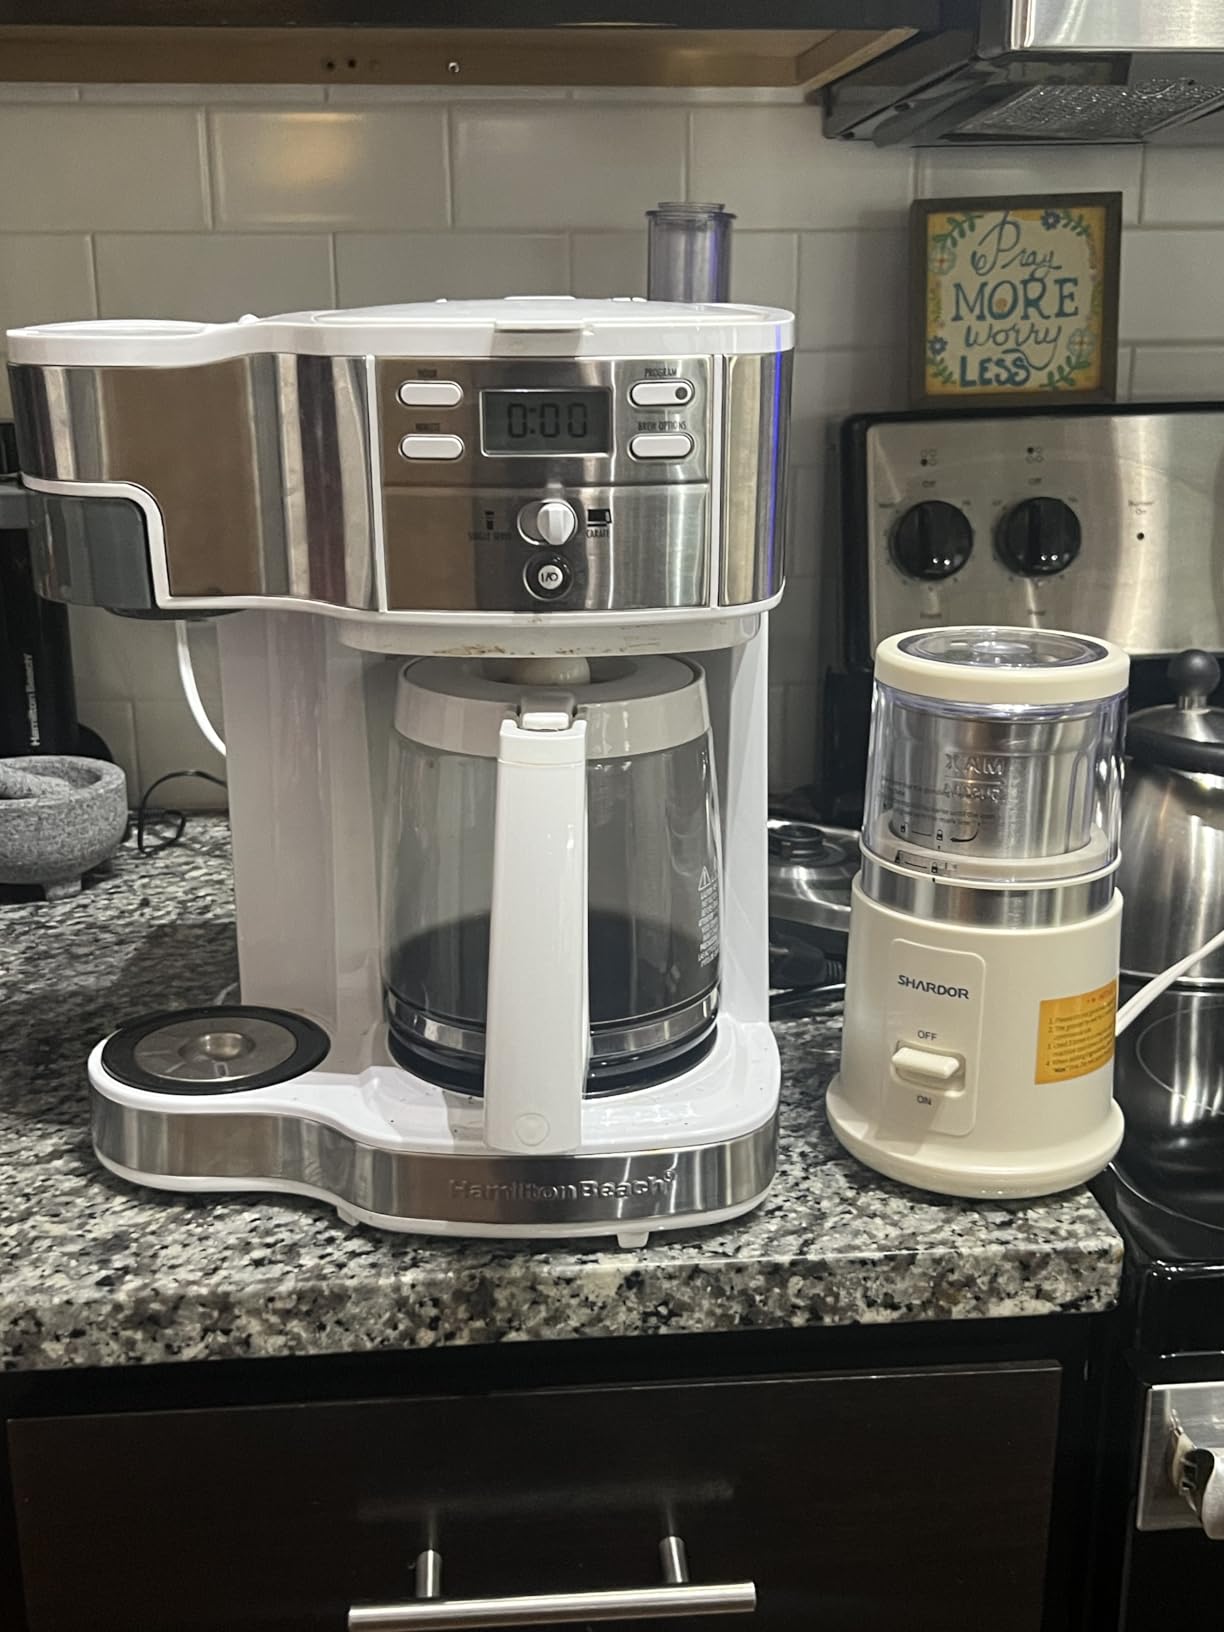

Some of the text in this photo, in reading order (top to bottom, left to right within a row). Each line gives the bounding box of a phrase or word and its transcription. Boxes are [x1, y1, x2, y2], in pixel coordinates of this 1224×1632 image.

[971, 209, 1062, 278] Pray
[952, 277, 1078, 321] MORE
[965, 323, 1062, 371] worry
[960, 355, 1031, 388] LESS
[507, 402, 588, 438] 0:00
[897, 974, 970, 1000] SHARDOR
[917, 1029, 938, 1041] OFF
[916, 1095, 933, 1106] ON
